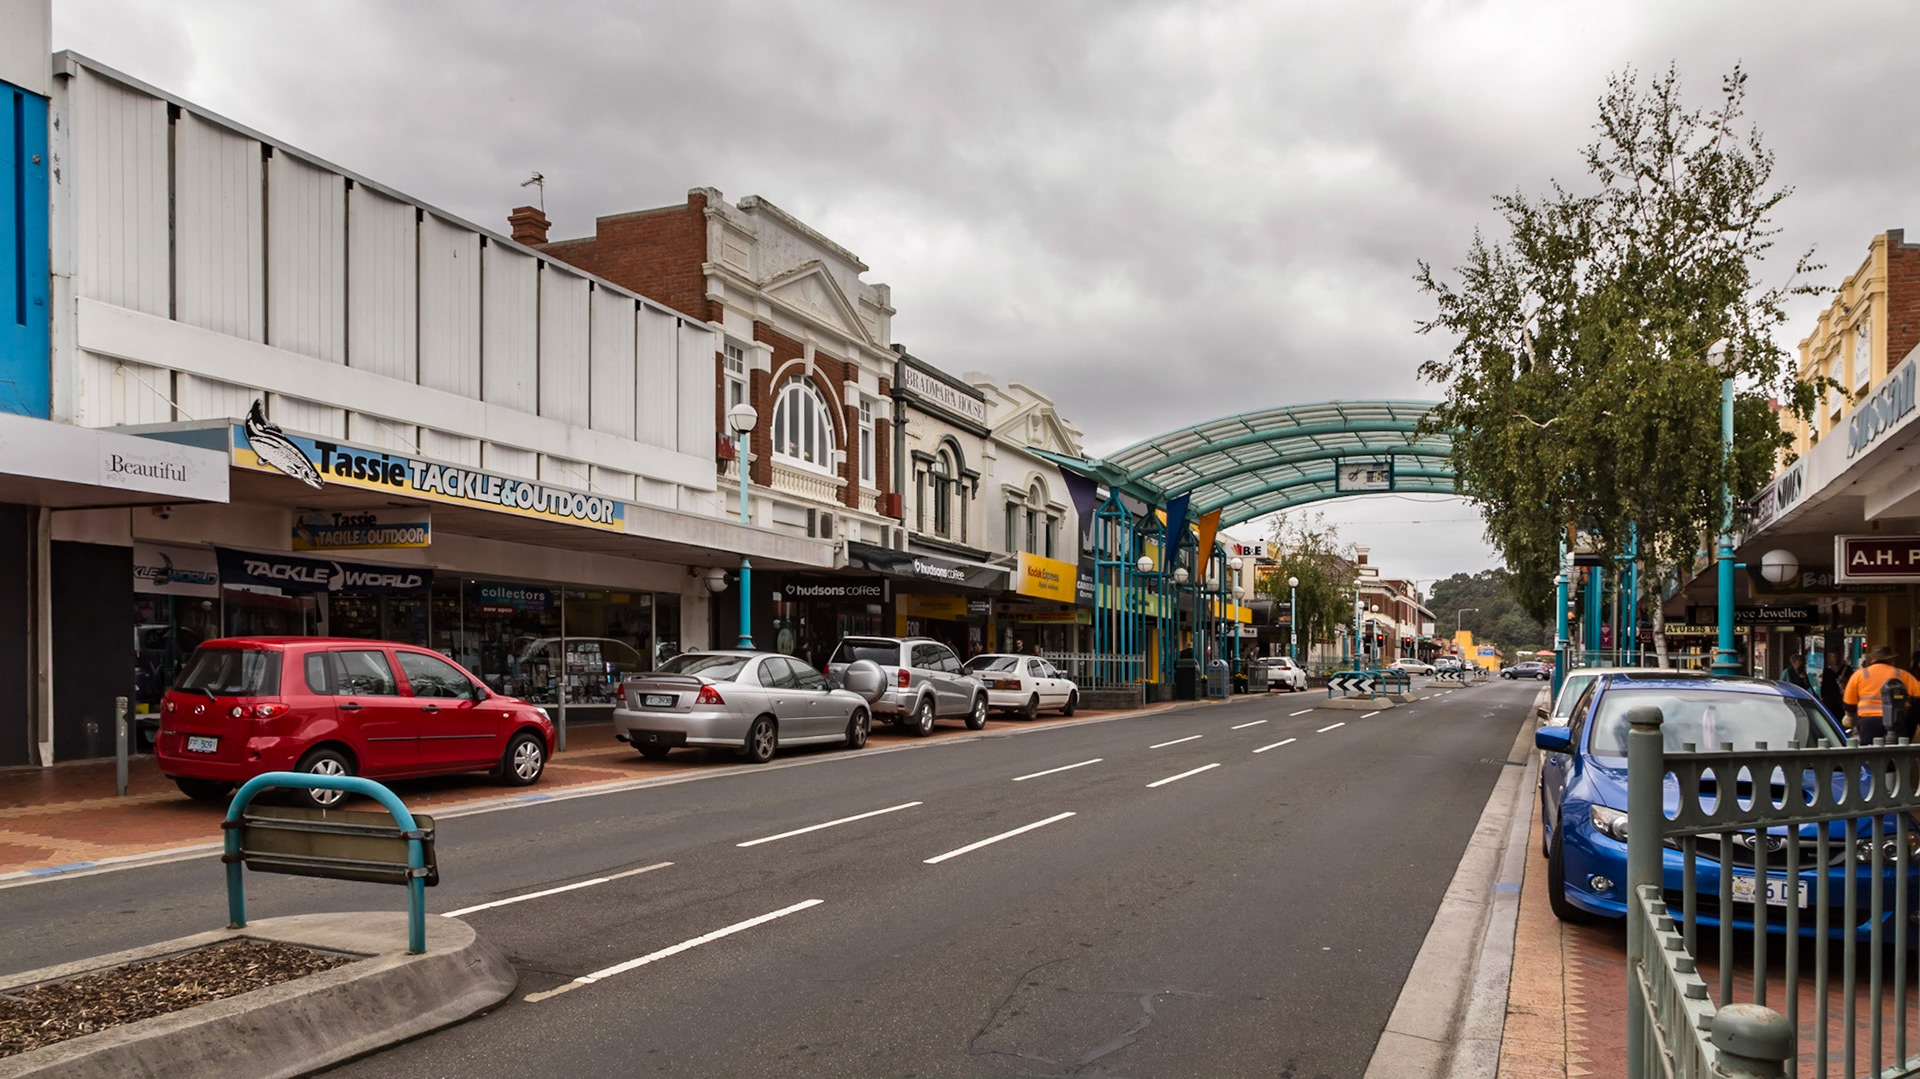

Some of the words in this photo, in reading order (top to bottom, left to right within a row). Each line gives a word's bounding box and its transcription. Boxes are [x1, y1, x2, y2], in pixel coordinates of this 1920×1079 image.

[906, 368, 956, 407] BRADMARA
[958, 394, 983, 420] HOUSE
[110, 453, 187, 482] Beautiful
[315, 440, 405, 487] Tassie
[409, 458, 615, 525] TACKLE&OUTDOOR
[331, 511, 378, 527] Tassie
[318, 527, 426, 546] TACKLE&OUTDOOR
[1243, 546, 1262, 556] B&E
[1851, 550, 1900, 566] A.H.
[133, 565, 159, 580] KLE
[167, 569, 219, 585] WORLD
[243, 560, 330, 584] TACKLE
[345, 571, 423, 589] WORLD
[921, 562, 948, 578] hudsons
[948, 569, 965, 581] coffee
[1028, 565, 1042, 578] Kodak
[1042, 568, 1060, 583] Express
[481, 587, 546, 601] collectors
[796, 585, 845, 596] hudsons
[846, 584, 881, 596] coffee
[1758, 608, 1808, 619] Jewellers
[907, 621, 920, 636] FOR
[969, 627, 981, 641] FOR
[1666, 625, 1706, 633] ATURES
